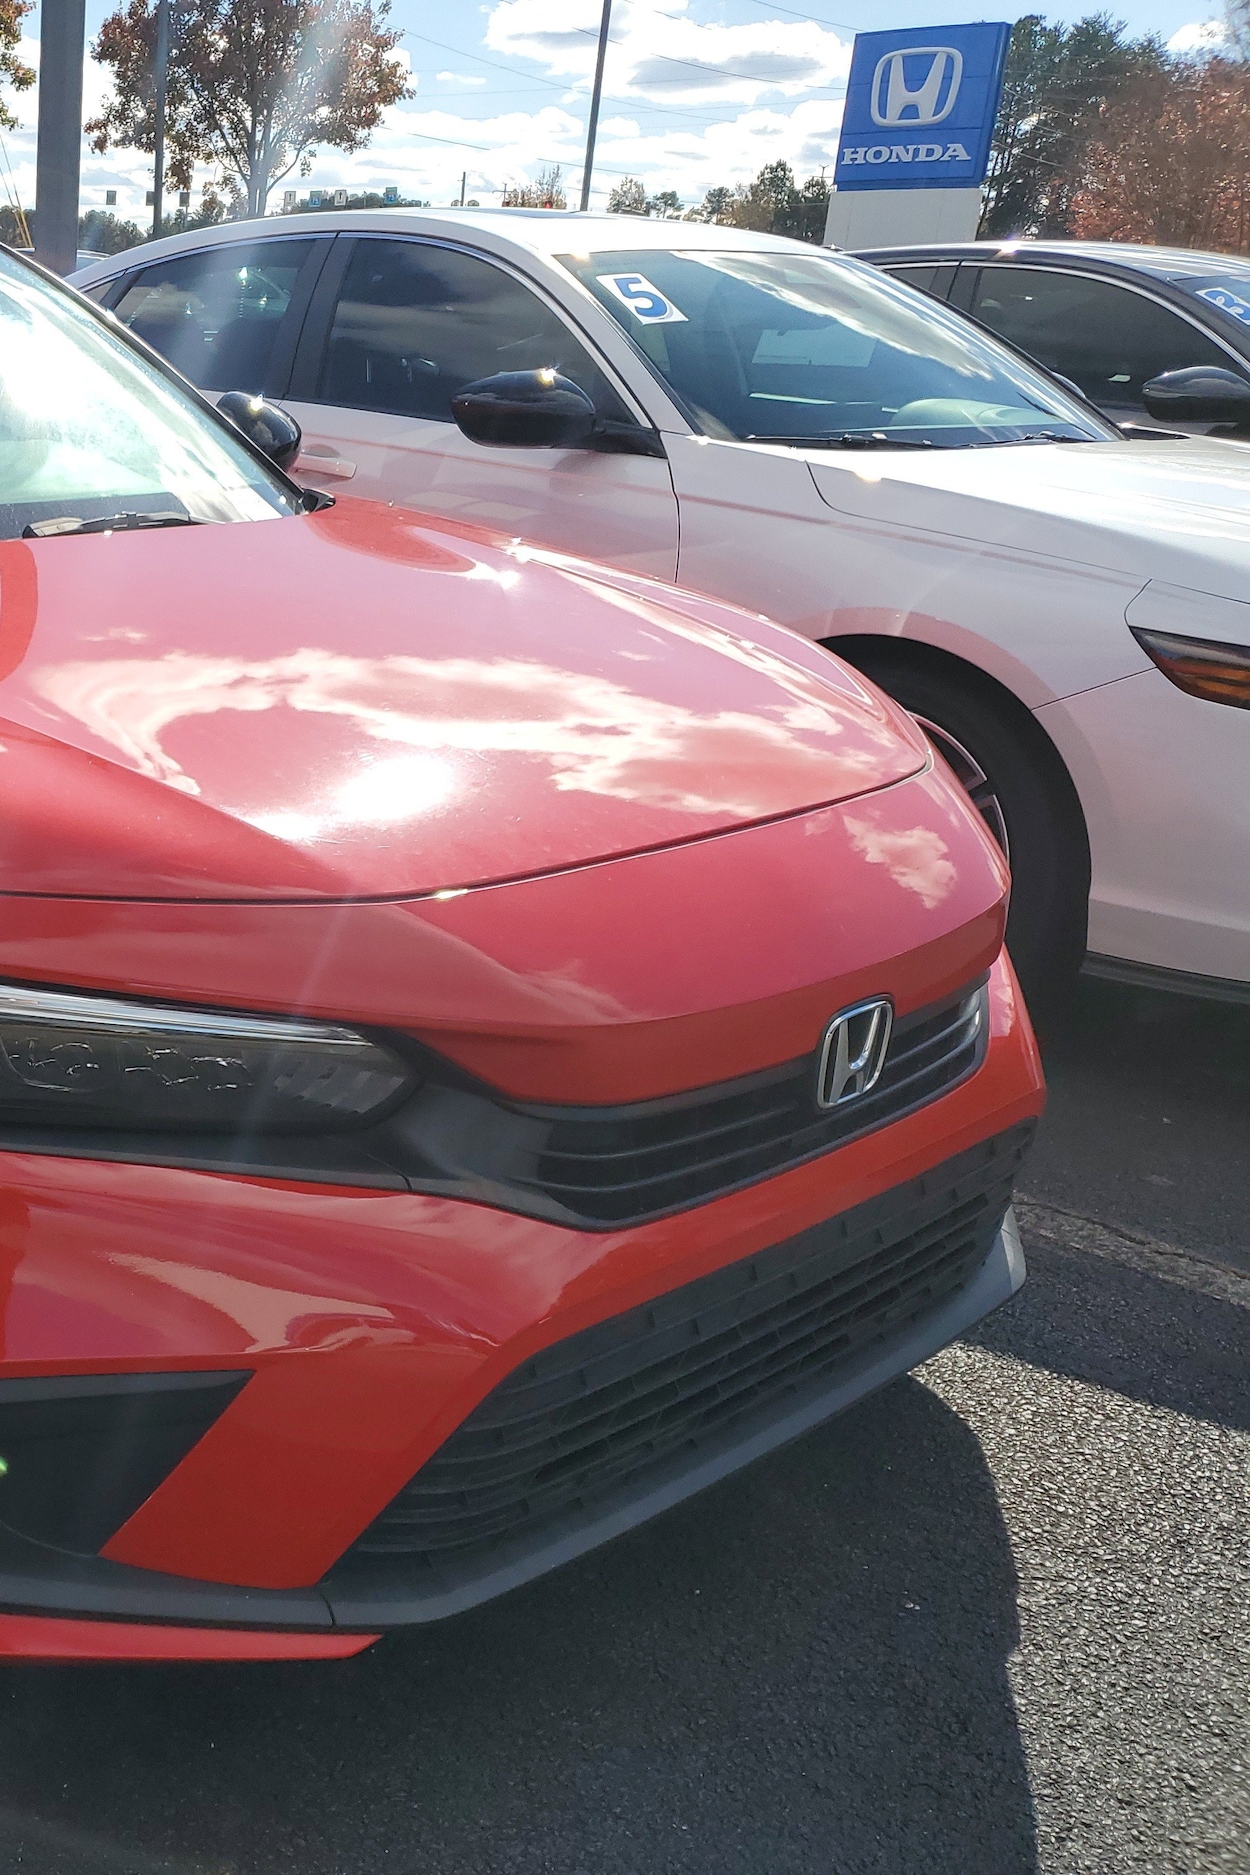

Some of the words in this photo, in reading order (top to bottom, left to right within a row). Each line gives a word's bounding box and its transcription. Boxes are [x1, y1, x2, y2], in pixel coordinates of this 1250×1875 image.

[840, 144, 972, 165] HONDA
[613, 276, 668, 318] 5
[1204, 289, 1250, 322] 3
